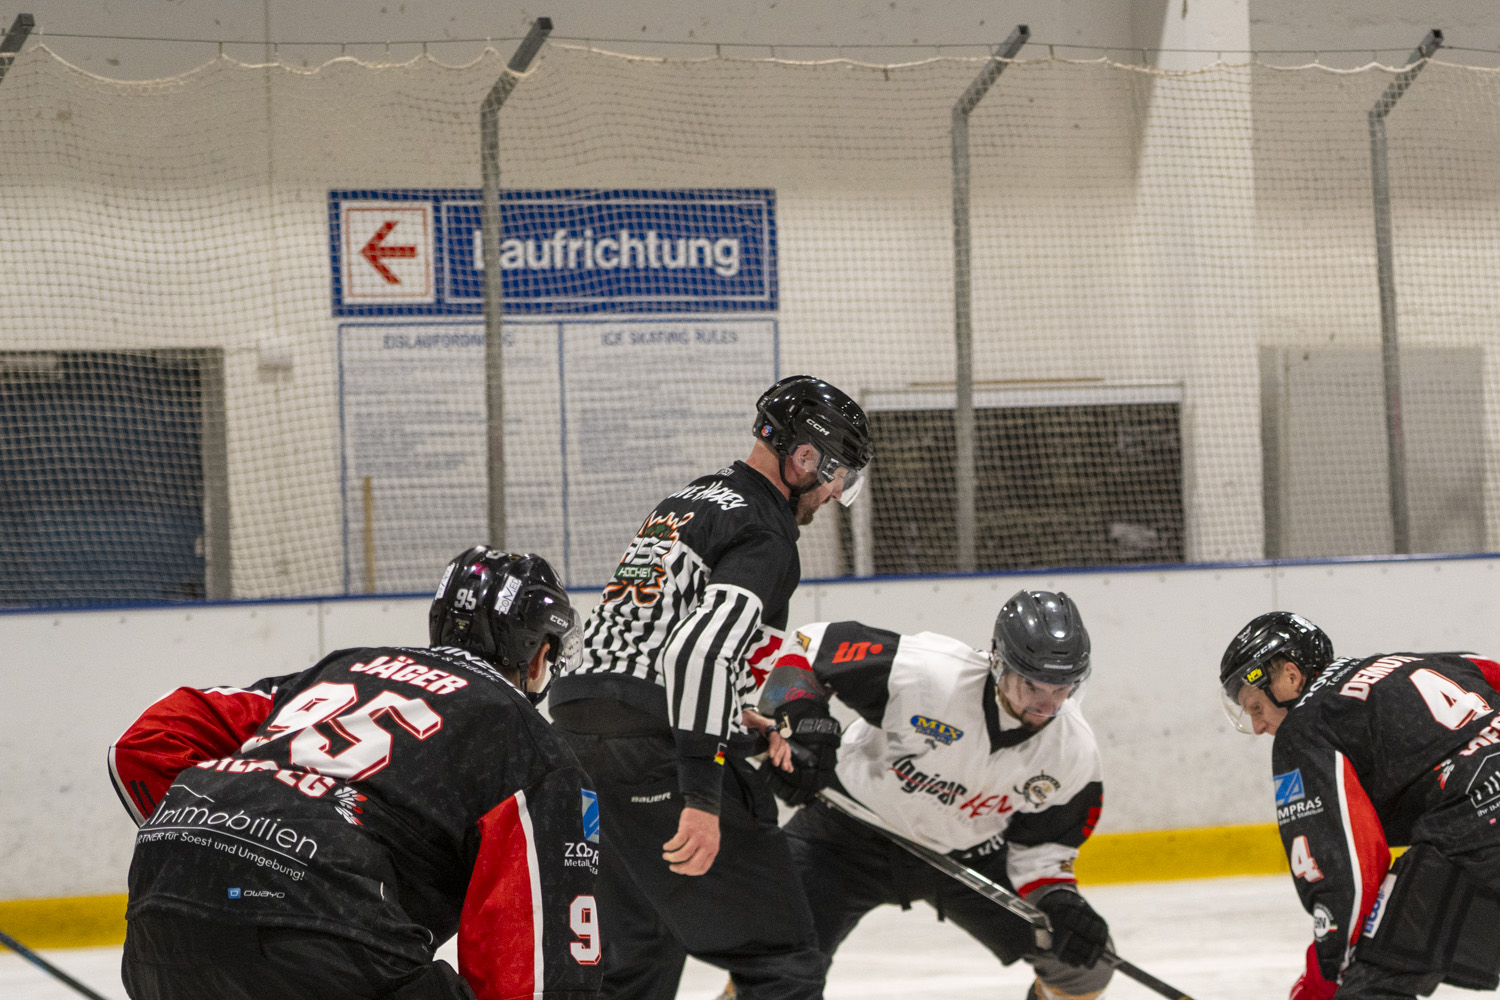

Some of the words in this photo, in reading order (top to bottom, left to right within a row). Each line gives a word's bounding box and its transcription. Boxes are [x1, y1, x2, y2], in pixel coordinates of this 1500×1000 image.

[806, 418, 831, 436] CCM
[453, 588, 478, 611] 95
[550, 614, 570, 629] CCM
[348, 655, 469, 695] JÄGER
[1409, 668, 1494, 731] 4
[240, 680, 442, 784] 95
[917, 718, 961, 739] MIX
[150, 800, 318, 860] Immobilien
[1277, 796, 1323, 820] MPRAS
[180, 831, 213, 848] Soest
[213, 842, 237, 855] und
[237, 848, 306, 882] Umgebung!
[1291, 835, 1324, 883] 4
[569, 895, 601, 966] 9
